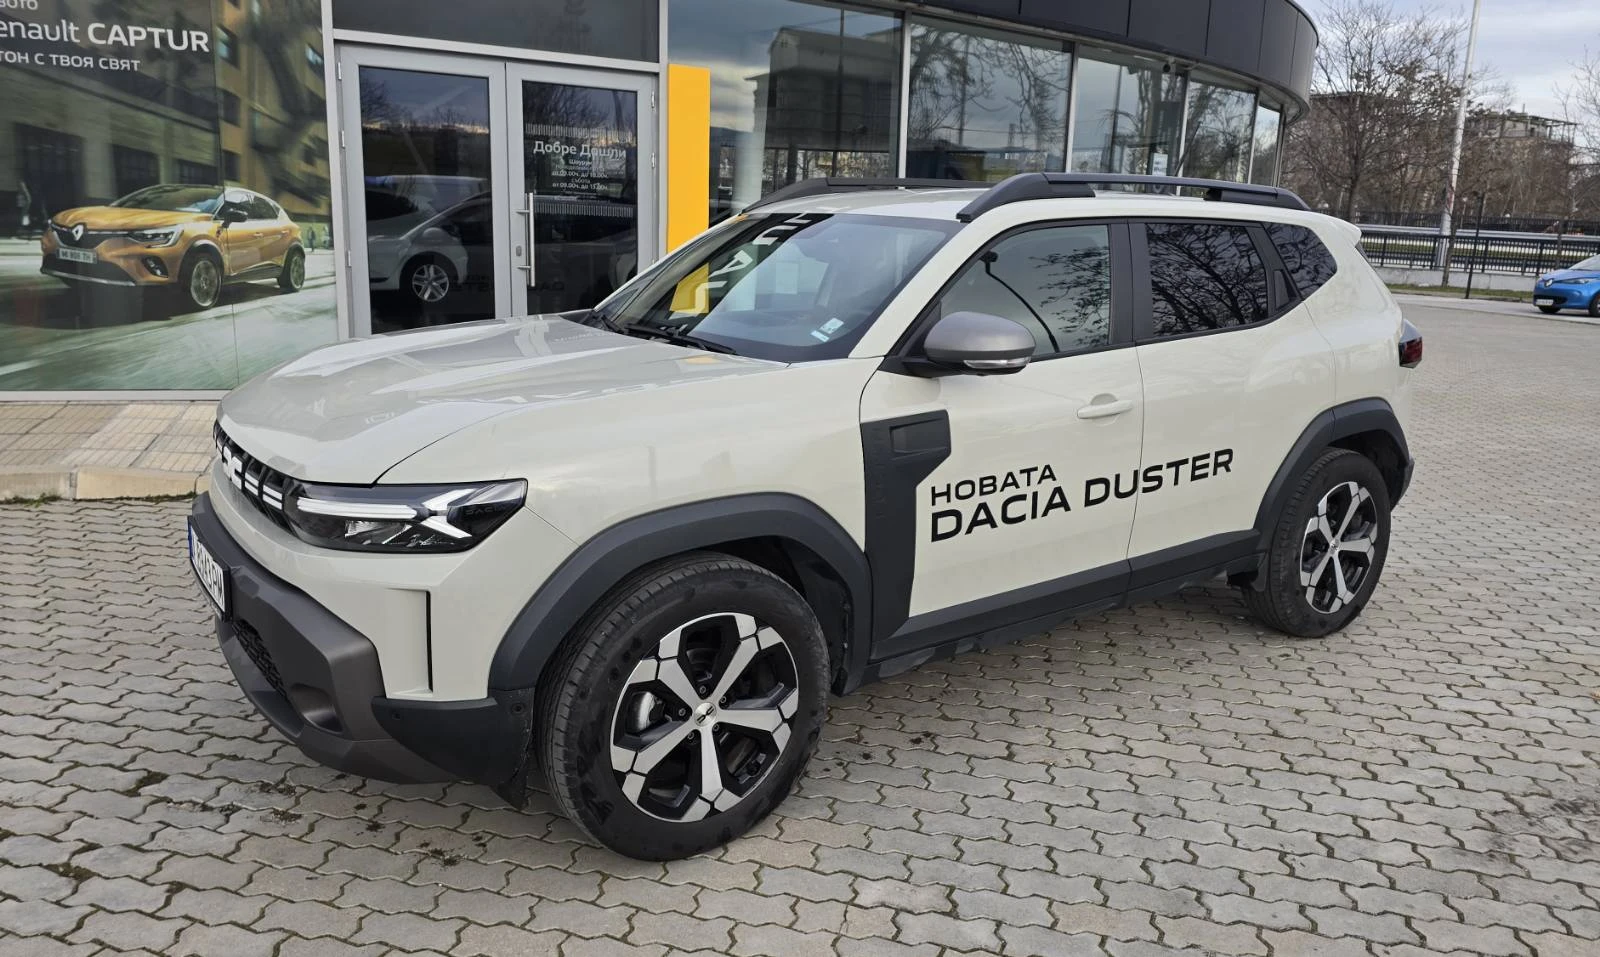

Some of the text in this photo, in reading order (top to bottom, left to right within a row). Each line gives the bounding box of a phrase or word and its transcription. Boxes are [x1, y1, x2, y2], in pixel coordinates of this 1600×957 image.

[87, 22, 210, 52] CAPTUR
[533, 141, 626, 161] Добре Дошли
[931, 448, 1233, 542] DACIA DUSTER
